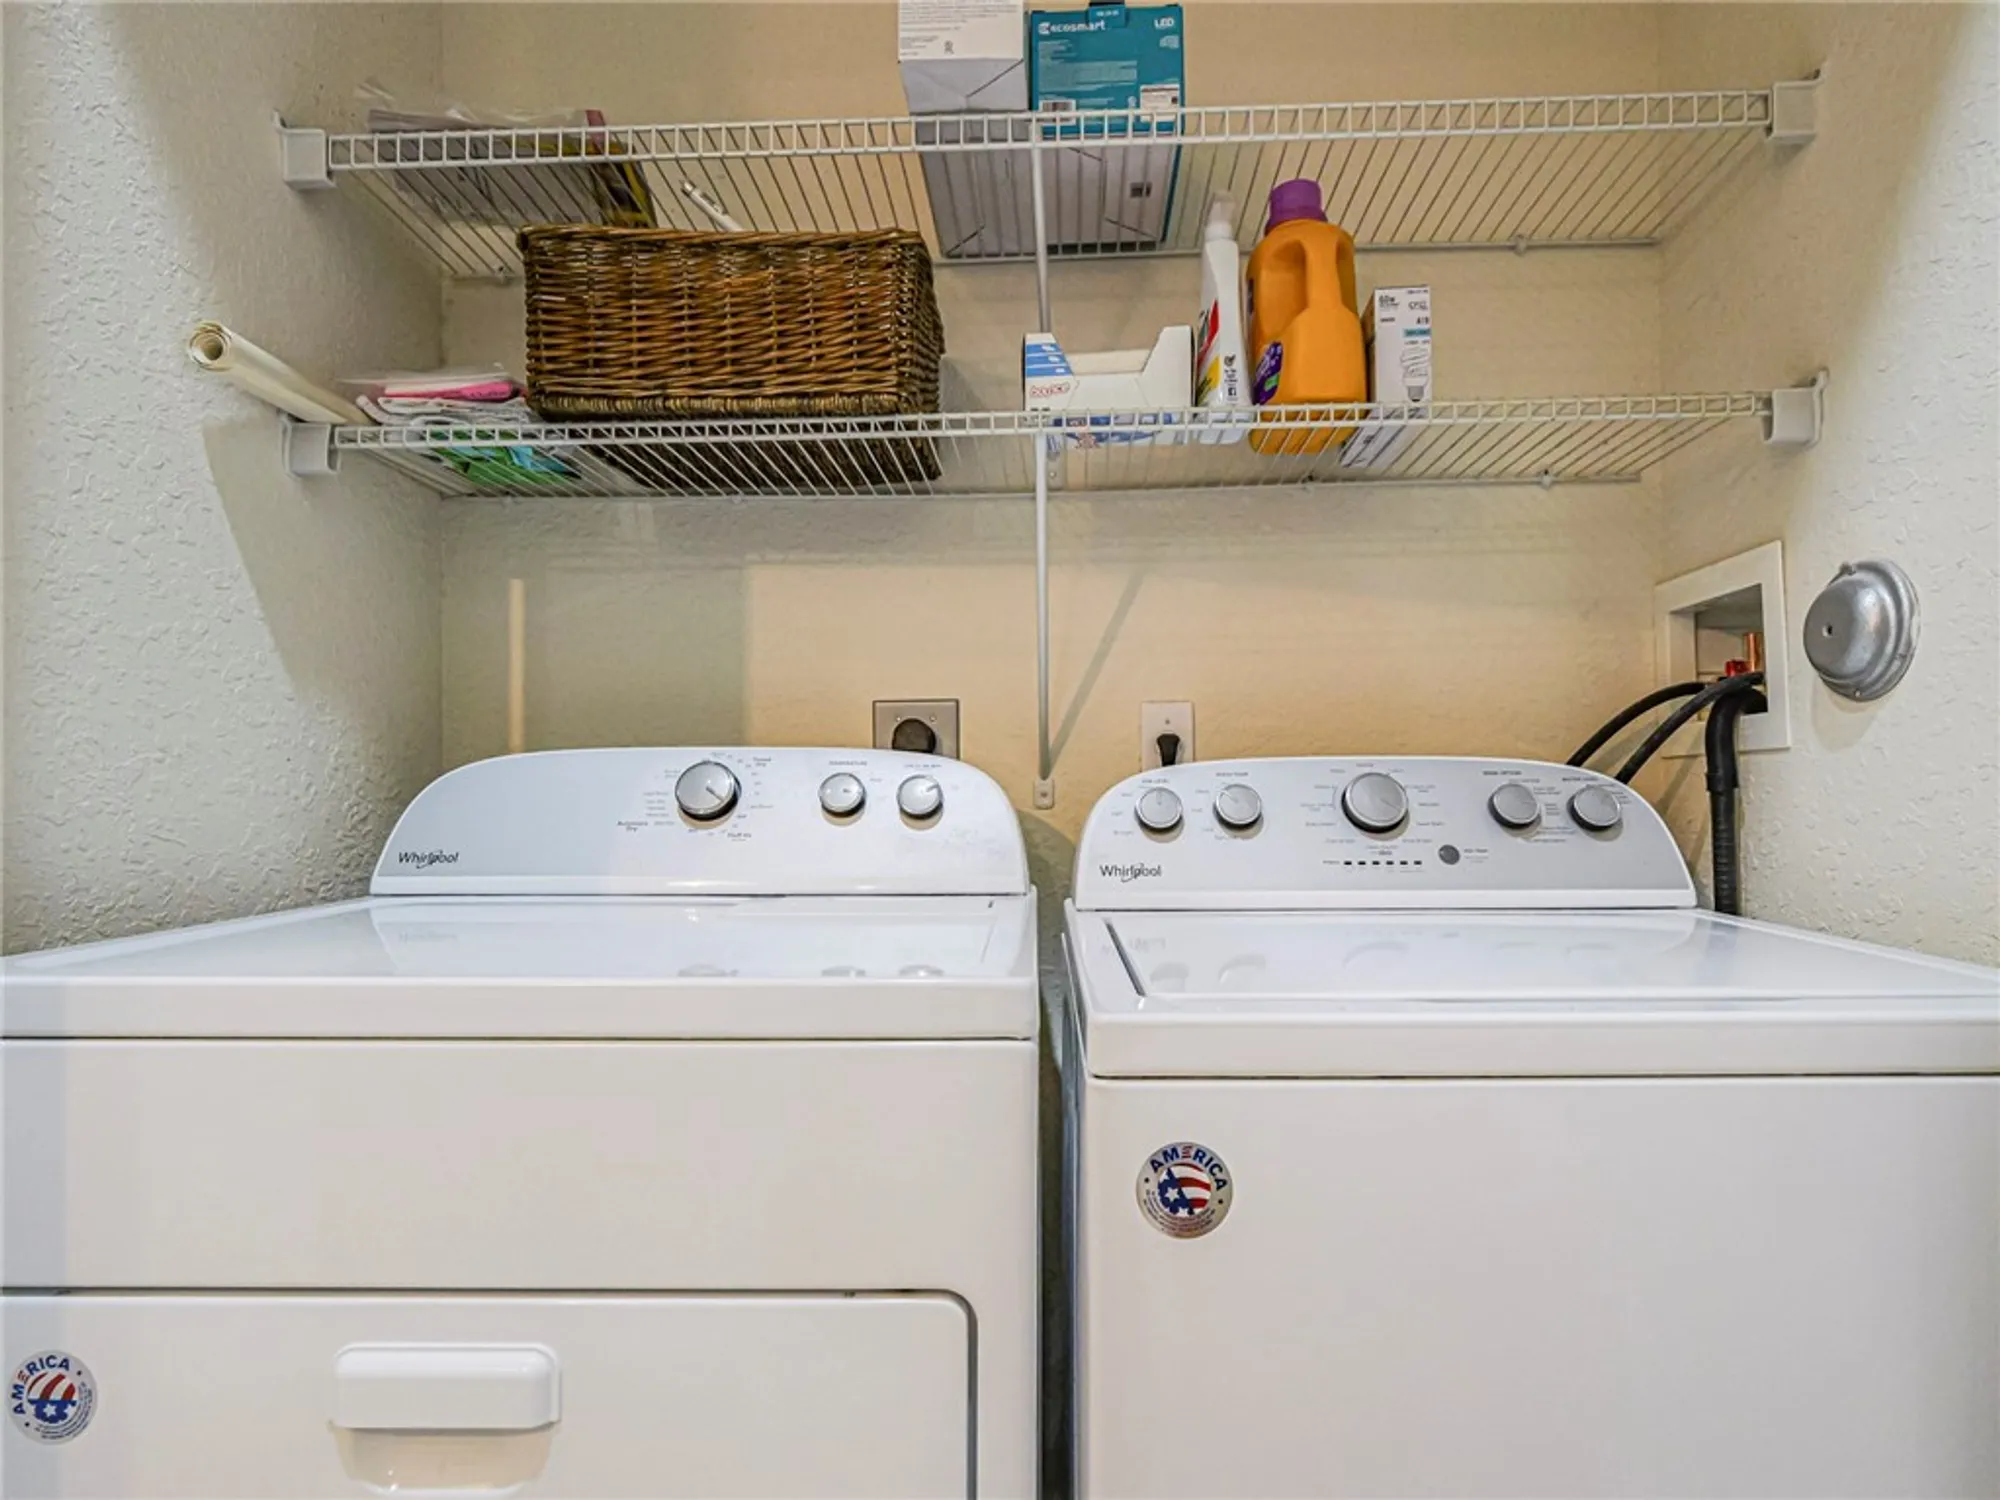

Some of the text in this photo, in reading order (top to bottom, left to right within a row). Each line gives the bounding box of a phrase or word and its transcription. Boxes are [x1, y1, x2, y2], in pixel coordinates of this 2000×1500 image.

[1050, 19, 1106, 33] ecosmart
[1153, 16, 1176, 30] LED
[398, 849, 460, 869] Whirlpool
[1099, 863, 1162, 883] Whirlpool
[1149, 1144, 1228, 1192] AMERICA
[11, 1354, 70, 1415] AMERICA
